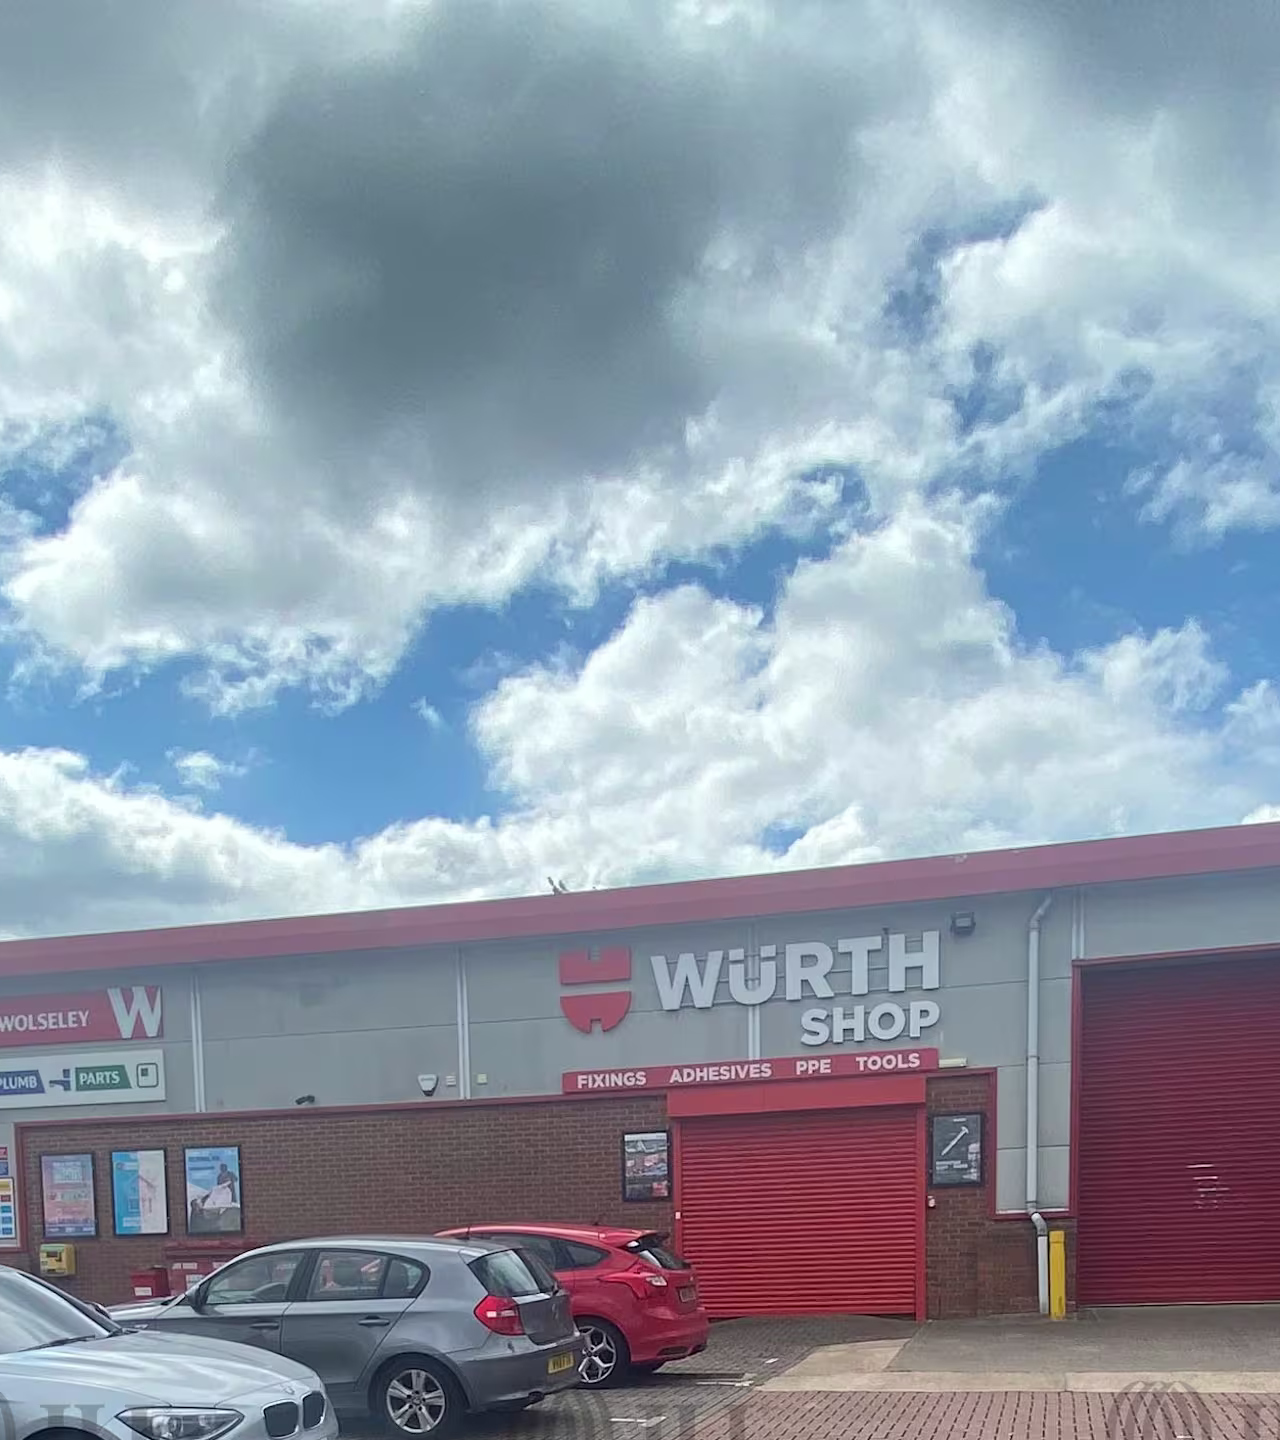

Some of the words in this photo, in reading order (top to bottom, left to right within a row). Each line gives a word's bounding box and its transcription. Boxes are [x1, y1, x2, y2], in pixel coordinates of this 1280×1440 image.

[650, 930, 940, 1011] WÜRTH
[107, 986, 162, 1039] W
[800, 1000, 941, 1046] SHOP
[79, 1070, 121, 1086] PARTS
[577, 1071, 647, 1090] FIXINGS
[670, 1062, 772, 1084] ADHESIVES
[796, 1058, 832, 1075] PPE
[855, 1052, 921, 1072] TOOLS
